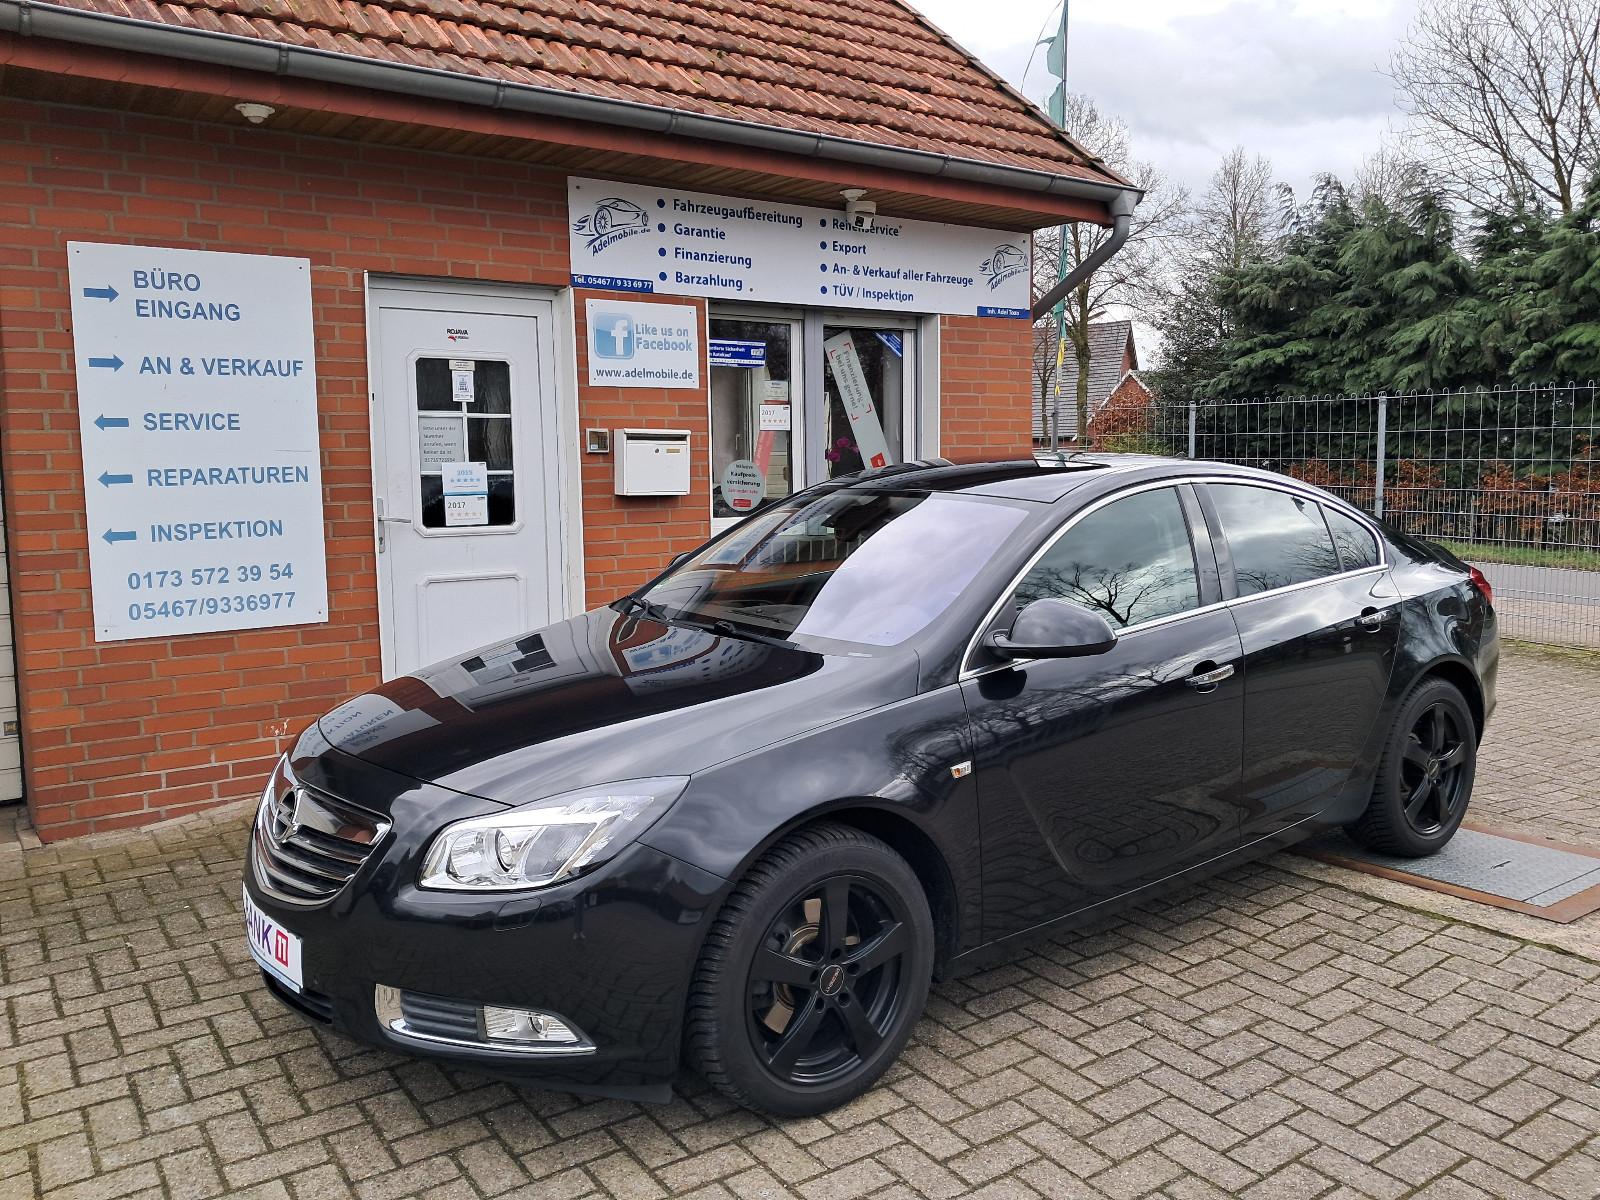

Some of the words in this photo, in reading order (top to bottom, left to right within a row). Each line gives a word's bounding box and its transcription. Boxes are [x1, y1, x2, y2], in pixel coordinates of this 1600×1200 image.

[673, 199, 803, 228] Fahrzeugaufbereitung
[674, 223, 726, 240] Garantie
[592, 228, 650, 257] Adelmobile.de
[832, 241, 867, 255] Export
[674, 247, 752, 269] Finanzierung
[133, 267, 201, 292] BÜRO
[573, 275, 587, 284] Tel.
[587, 276, 611, 286] 05467
[622, 279, 632, 288] 33
[632, 280, 642, 289] 69
[643, 281, 652, 289] 77
[675, 271, 743, 292] Barzahlung
[832, 263, 851, 275] An-
[853, 265, 860, 276] &
[862, 266, 900, 280] Verkauf
[902, 270, 924, 282] aller
[925, 271, 974, 288] Fahrzeuge
[832, 283, 854, 297] TÜV
[856, 287, 860, 298] /
[862, 289, 914, 303] Inspektion
[135, 299, 241, 321] EINGANG
[635, 323, 658, 336] Like
[661, 327, 673, 337] us
[676, 328, 689, 337] on
[636, 337, 693, 352] Facebook
[139, 356, 172, 375] AN
[179, 357, 195, 375] &
[201, 358, 304, 377] VERKAUF
[596, 368, 693, 380] www.adelmobile.de
[143, 412, 241, 431] SERVICE
[147, 466, 309, 487] REPARATUREN
[447, 501, 466, 509] 2017
[150, 519, 283, 543] INSPEKTION
[127, 570, 183, 590] 0173
[191, 567, 230, 586] 572
[237, 565, 262, 583] 39
[269, 563, 294, 580] 54
[128, 591, 296, 621] 05467/9336977
